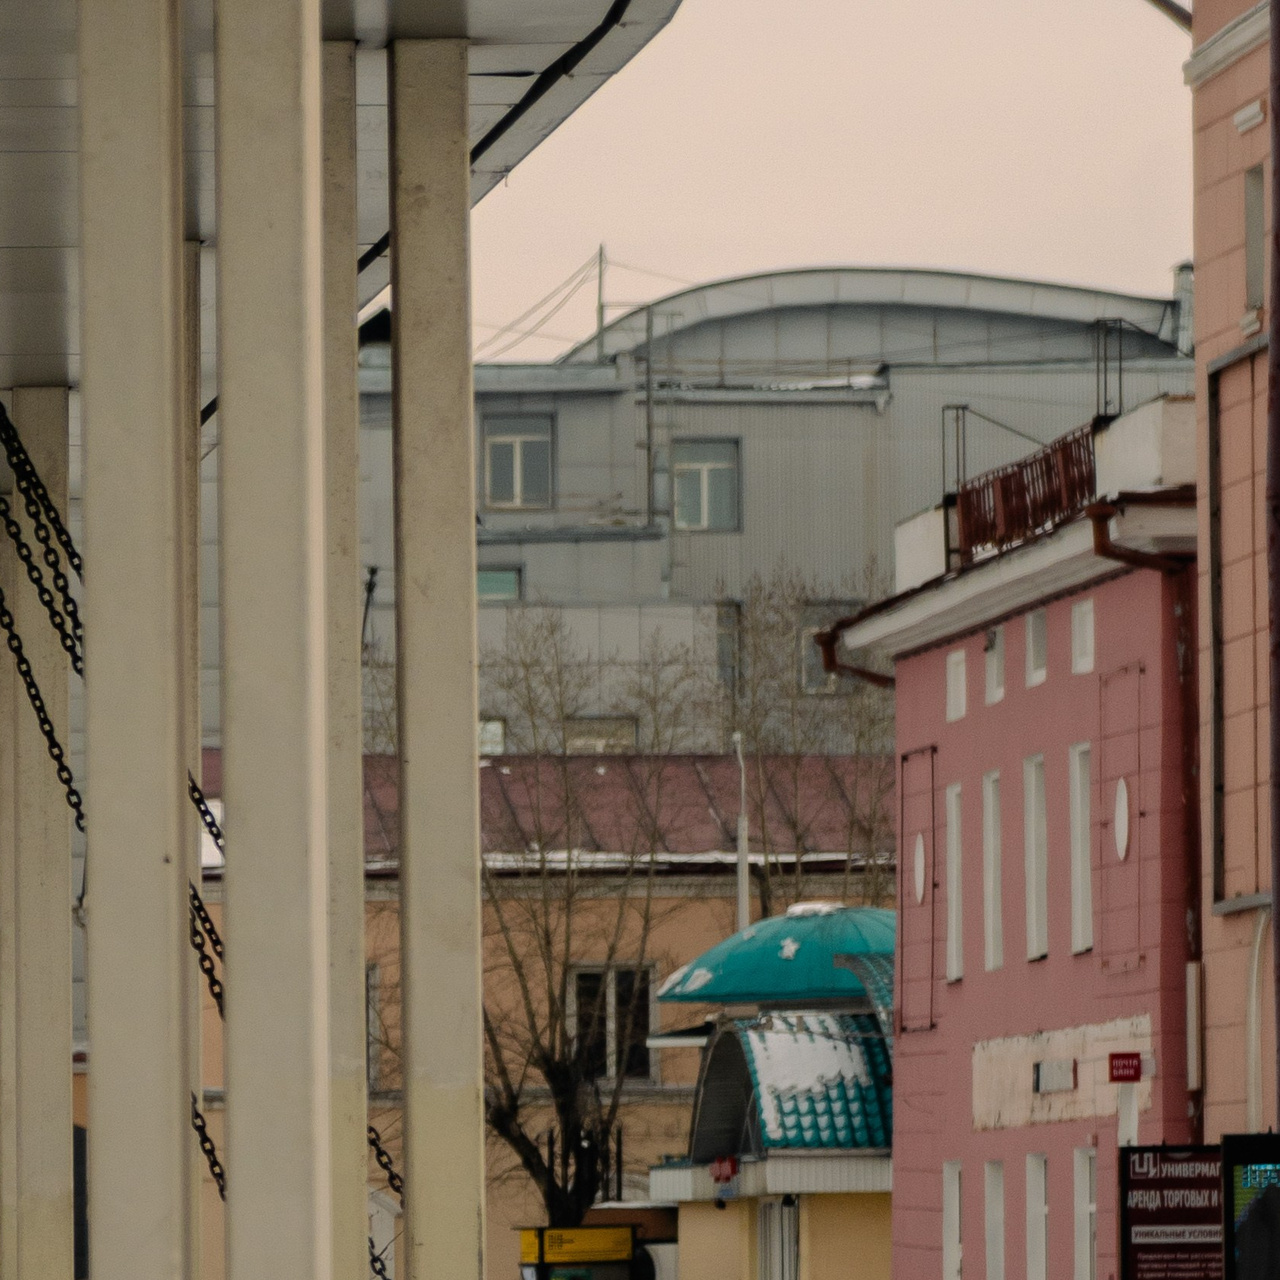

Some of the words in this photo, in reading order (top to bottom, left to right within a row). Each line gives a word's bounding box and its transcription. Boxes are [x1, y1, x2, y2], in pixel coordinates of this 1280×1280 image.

[1160, 1161, 1222, 1178] УНИВЕРМАГ
[1127, 1189, 1161, 1212] АРЕНДА
[1162, 1188, 1210, 1208] ТОРГОВЫХ
[1211, 1188, 1219, 1208] И
[1133, 1228, 1186, 1239] УНИКАЛЬНЫЕ
